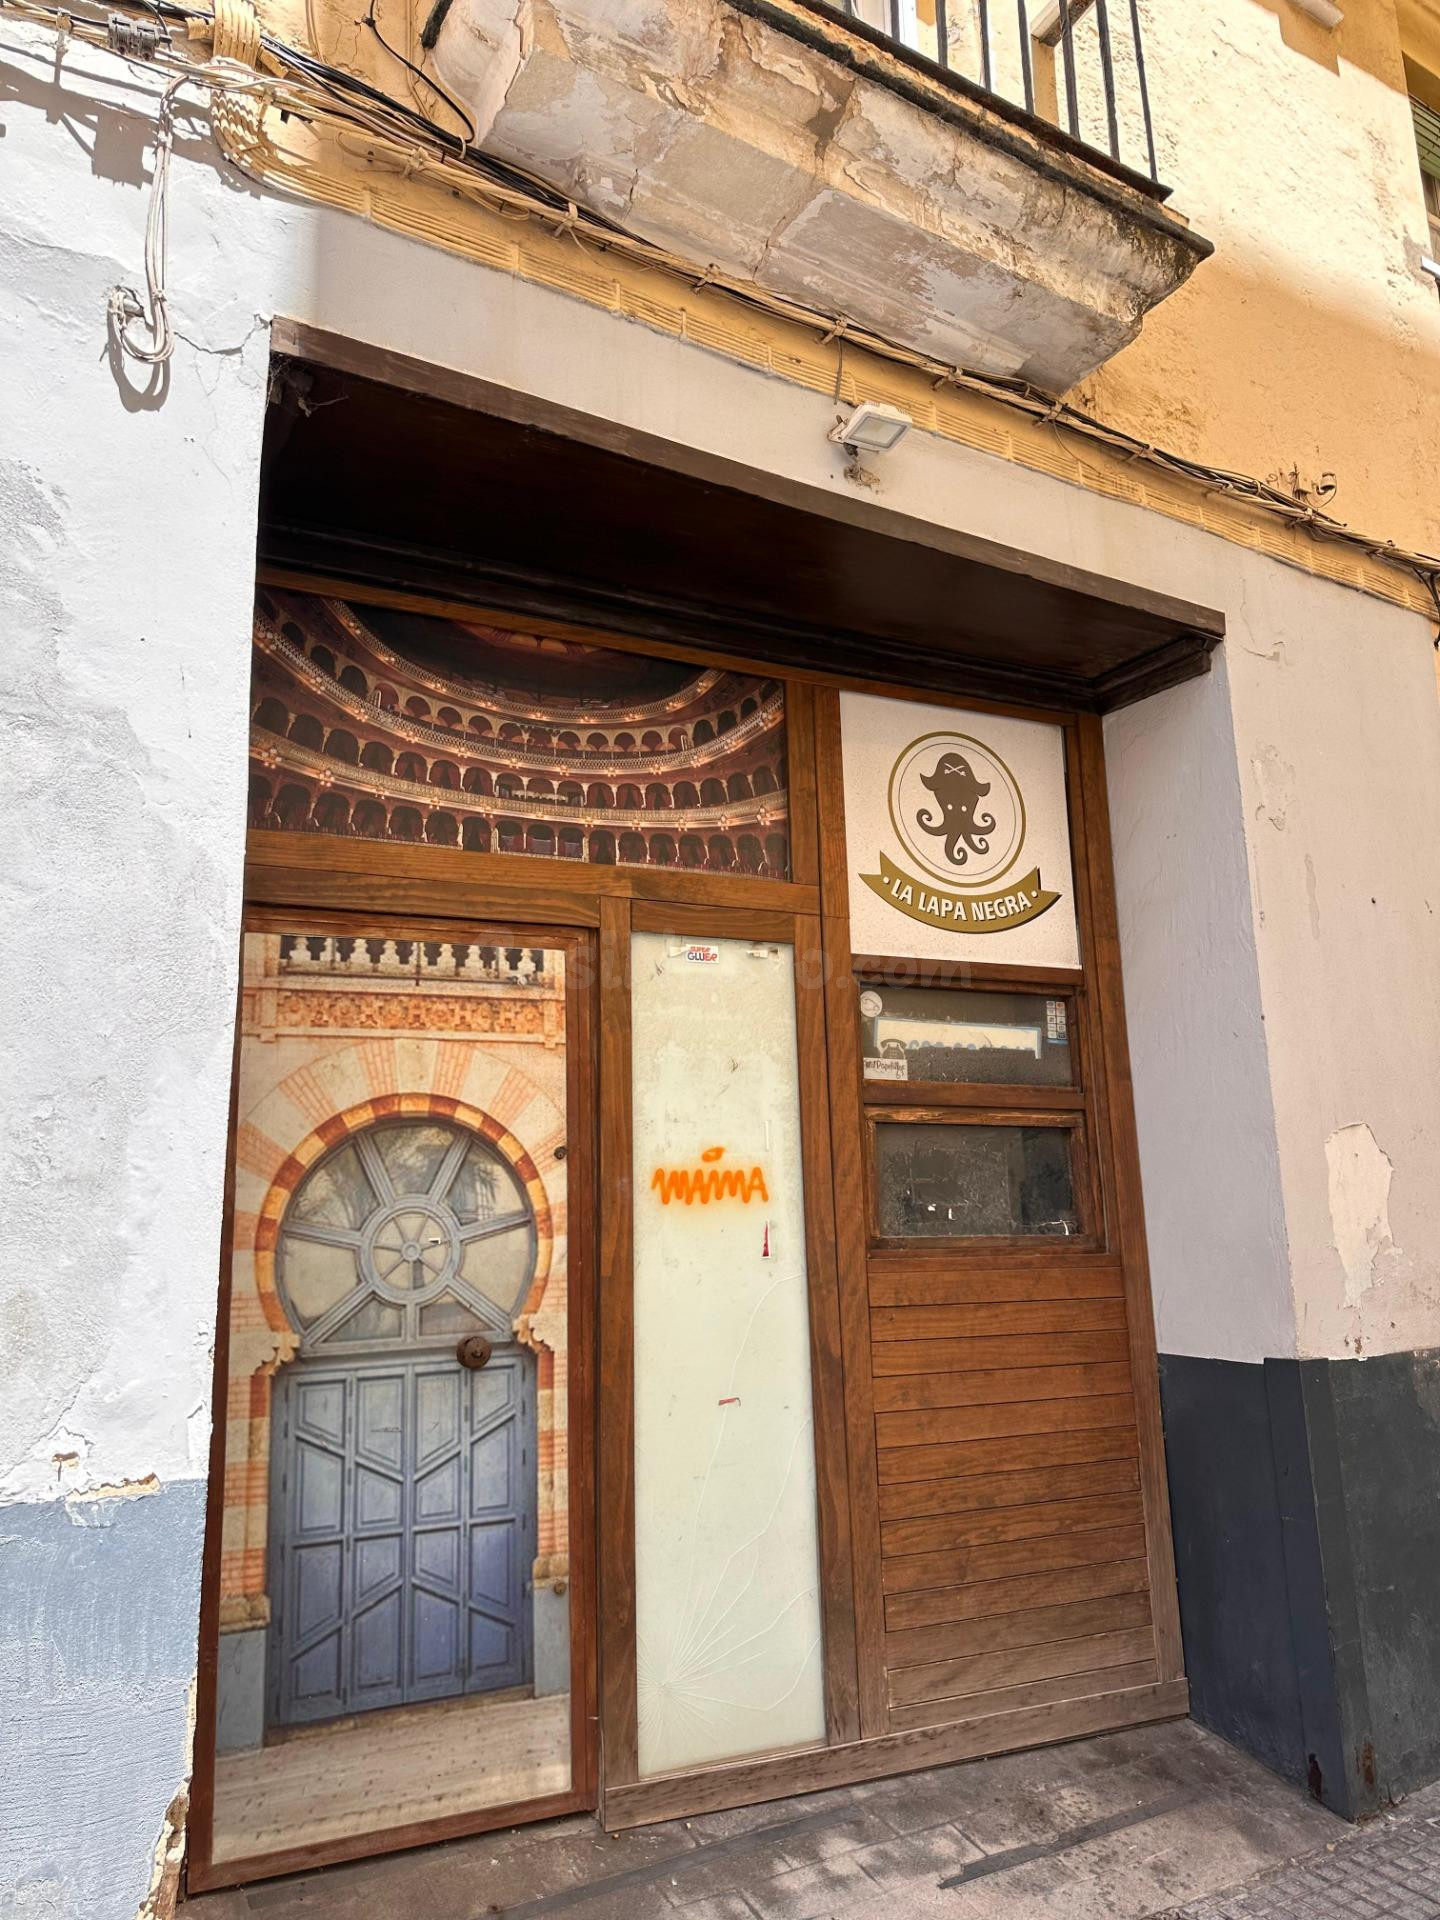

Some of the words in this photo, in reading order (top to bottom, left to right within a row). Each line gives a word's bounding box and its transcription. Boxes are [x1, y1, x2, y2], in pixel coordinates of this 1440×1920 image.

[891, 880, 912, 905] LA
[918, 891, 968, 921] LAPA
[971, 891, 1032, 921] NEGRA
